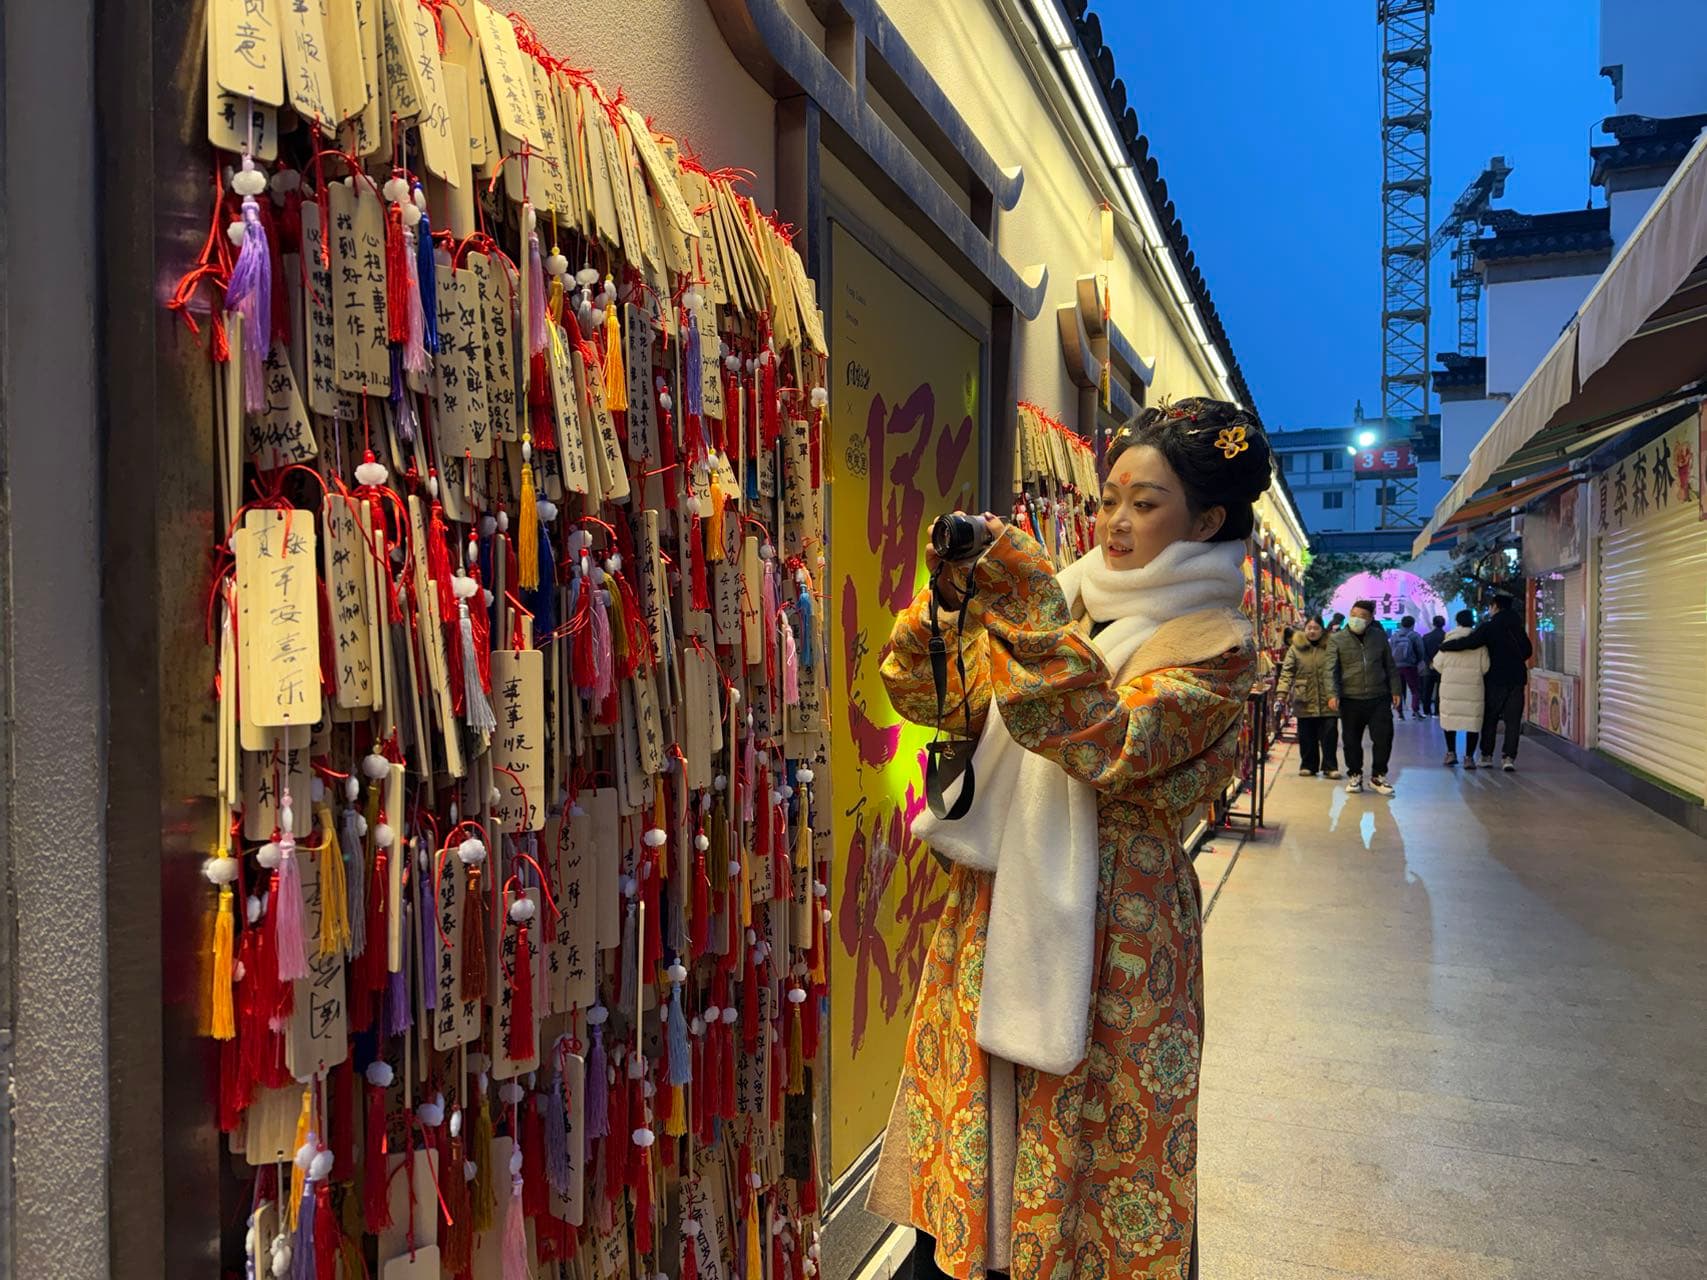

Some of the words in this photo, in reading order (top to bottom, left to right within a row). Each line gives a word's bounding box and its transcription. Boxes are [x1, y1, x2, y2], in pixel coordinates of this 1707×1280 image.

[362, 231, 389, 350] 心想事成
[1599, 437, 1676, 533] 夏季森林
[269, 564, 307, 706] 平安喜乐
[502, 676, 534, 773] 事事顺心
